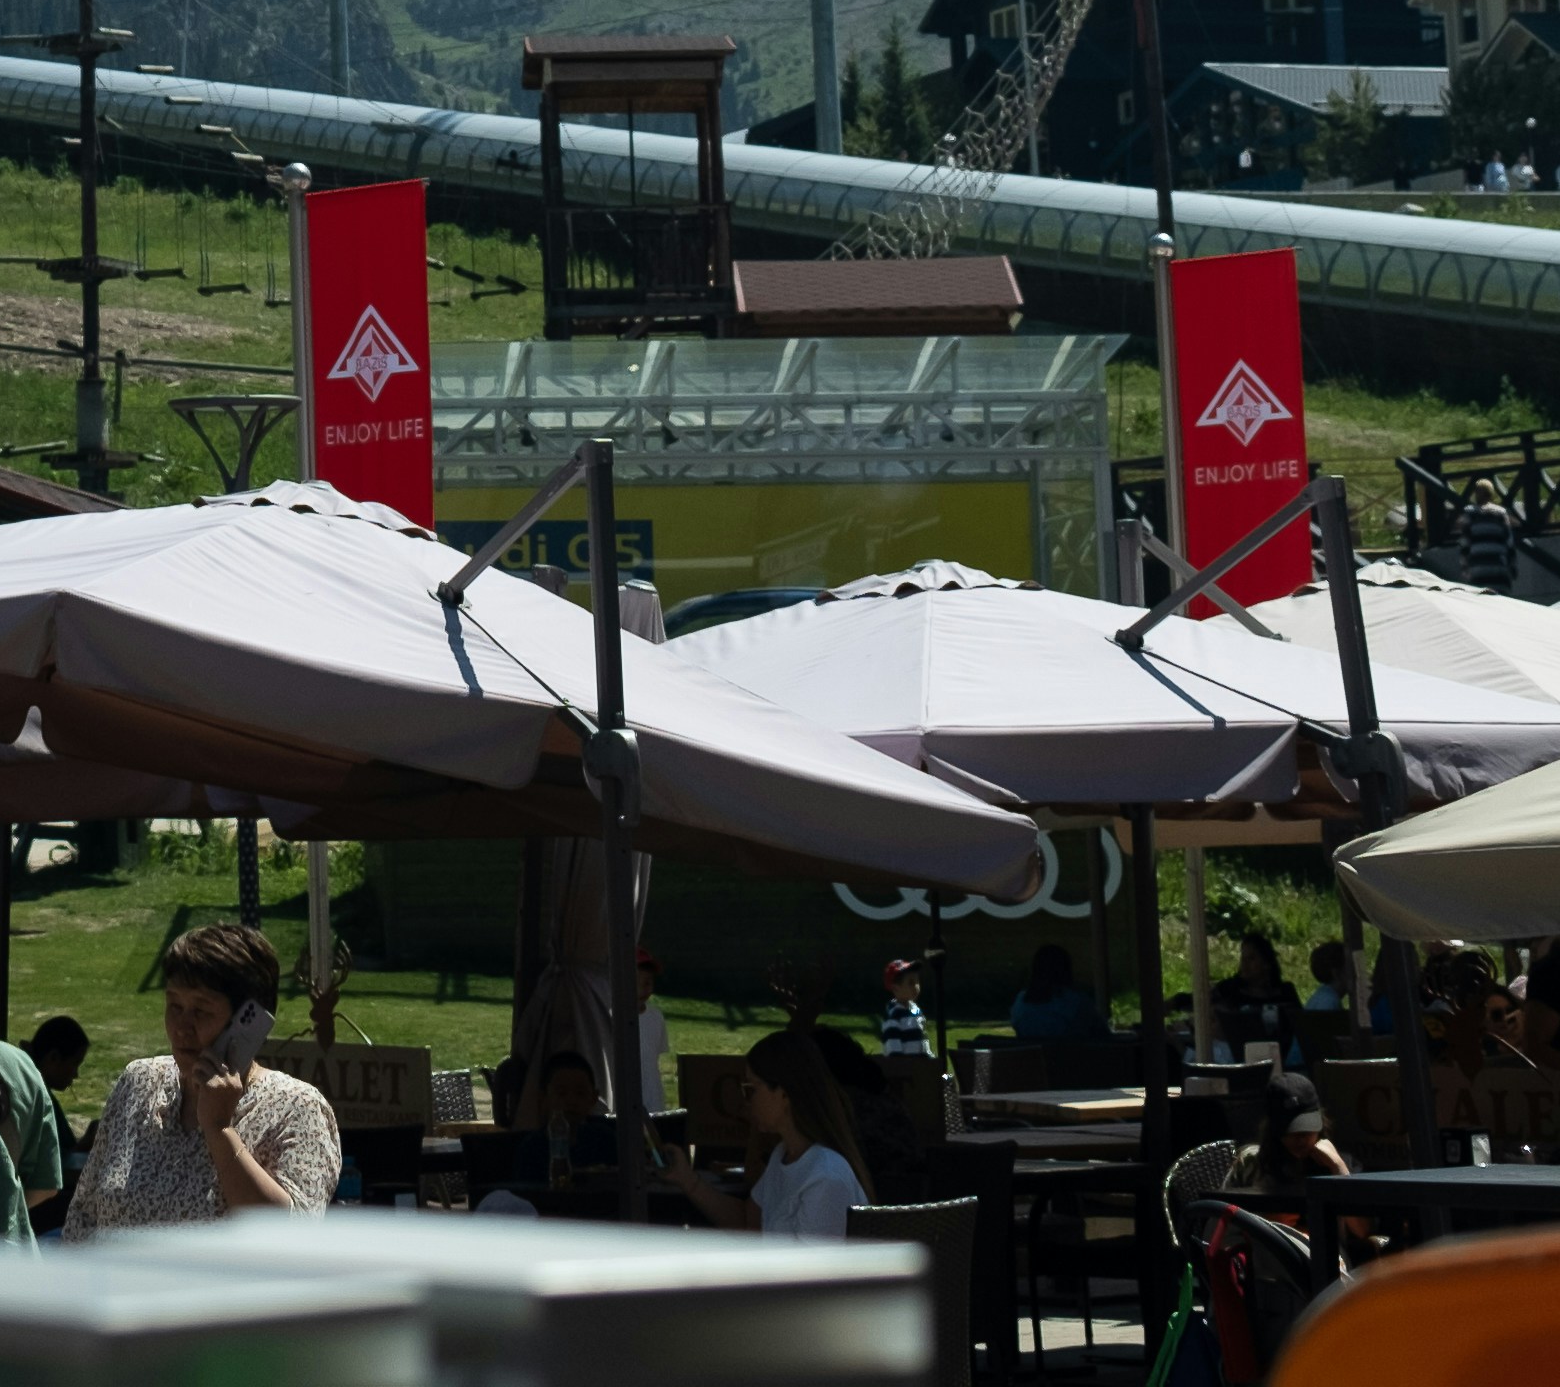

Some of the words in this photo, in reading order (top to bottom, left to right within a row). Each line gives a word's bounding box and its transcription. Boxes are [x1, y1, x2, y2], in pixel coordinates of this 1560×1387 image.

[325, 421, 382, 446] ENJOY
[388, 417, 425, 441] LIFE
[1194, 463, 1255, 486] ENJOY
[1263, 459, 1299, 480] LIFE
[256, 1055, 409, 1106] ALET
